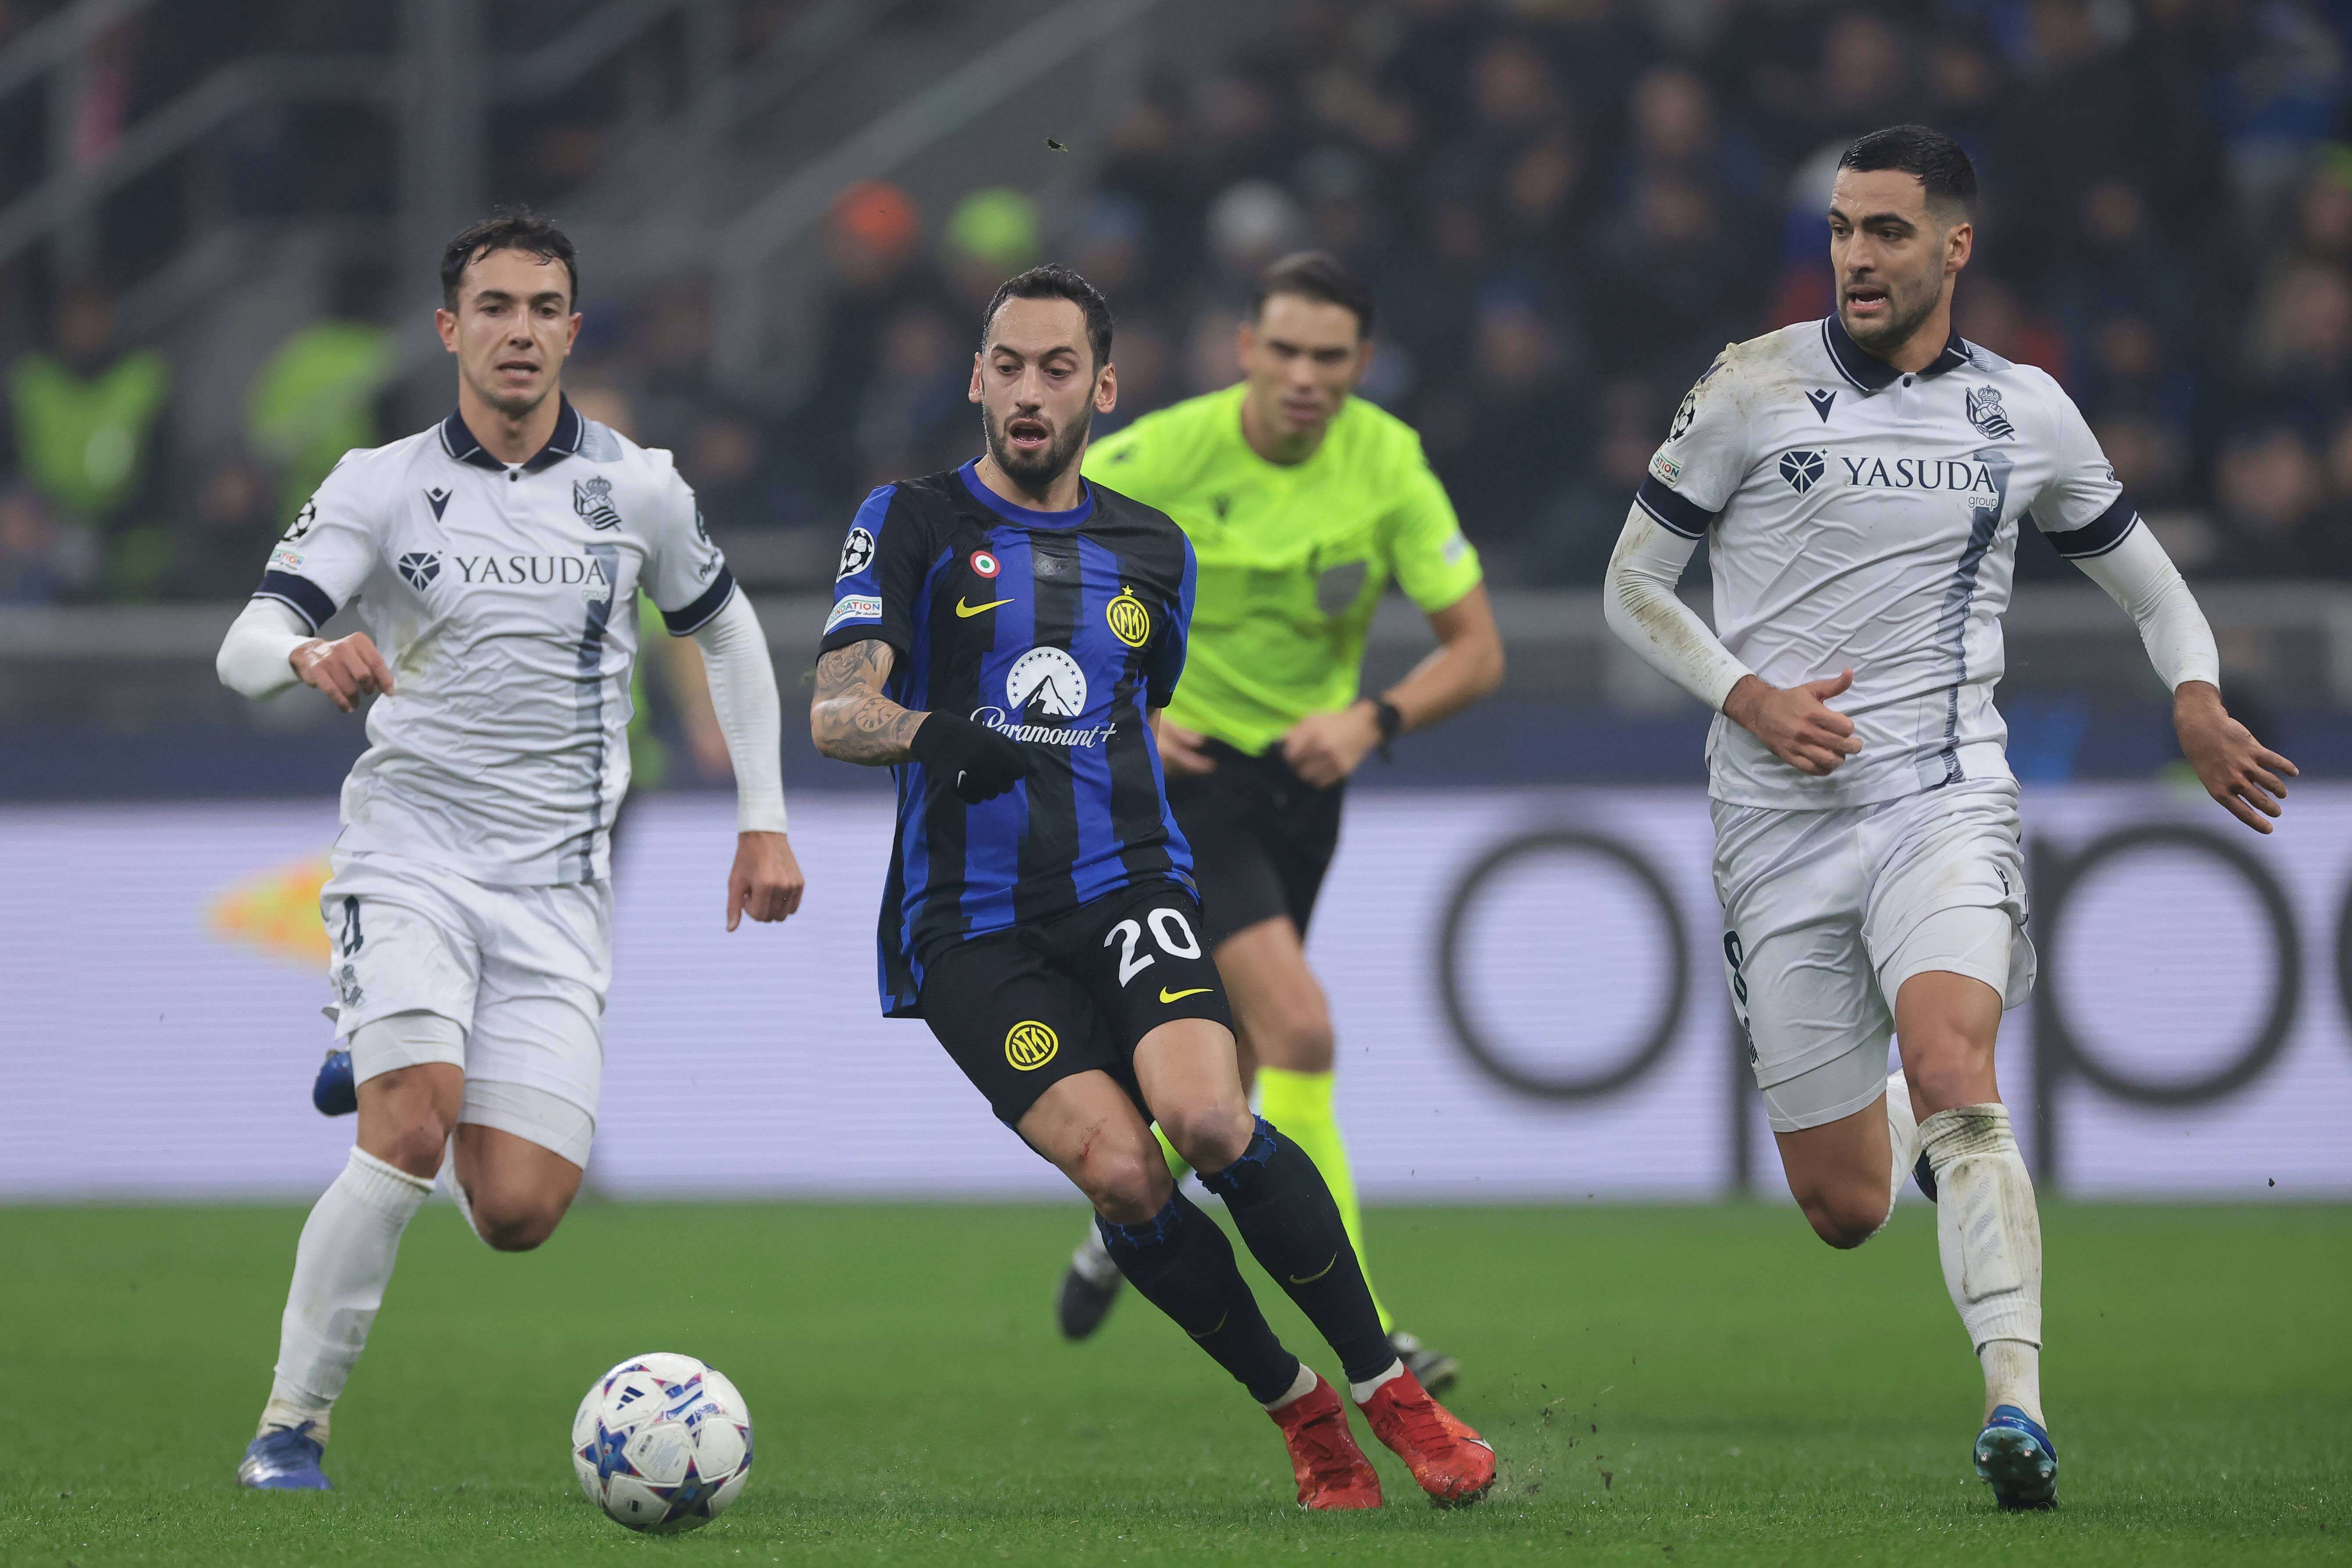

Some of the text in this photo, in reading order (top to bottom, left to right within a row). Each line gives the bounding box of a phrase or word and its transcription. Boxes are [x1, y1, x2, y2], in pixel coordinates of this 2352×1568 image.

[1839, 457, 1998, 493] YASUDA
[1968, 496, 1998, 511] group
[453, 555, 608, 586] YASUDA
[1103, 907, 1202, 988] 20
[1723, 930, 1748, 1007] 8
[1437, 825, 2352, 1193] op
